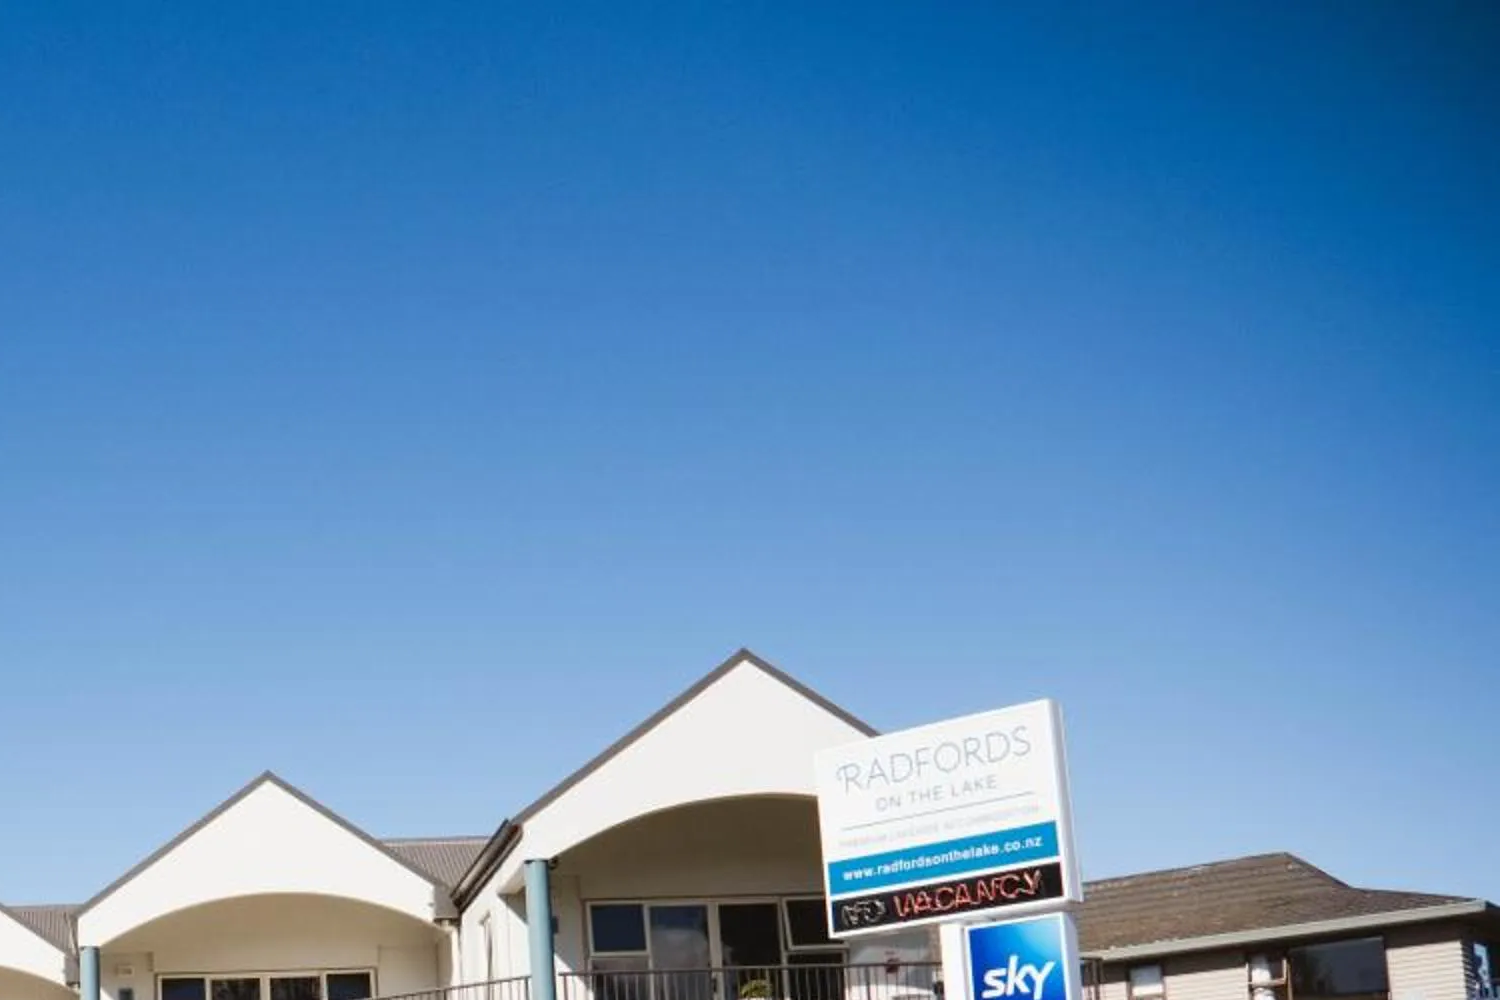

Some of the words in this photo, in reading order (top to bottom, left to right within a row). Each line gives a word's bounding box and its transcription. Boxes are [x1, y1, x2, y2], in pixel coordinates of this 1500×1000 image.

[836, 726, 1031, 794] RADFORDS
[875, 796, 902, 812] ON
[909, 785, 944, 806] THE
[950, 775, 998, 797] LAKE
[842, 836, 1044, 881] www.radfordsonthelake.co.nz
[893, 869, 1042, 917] VACANCY
